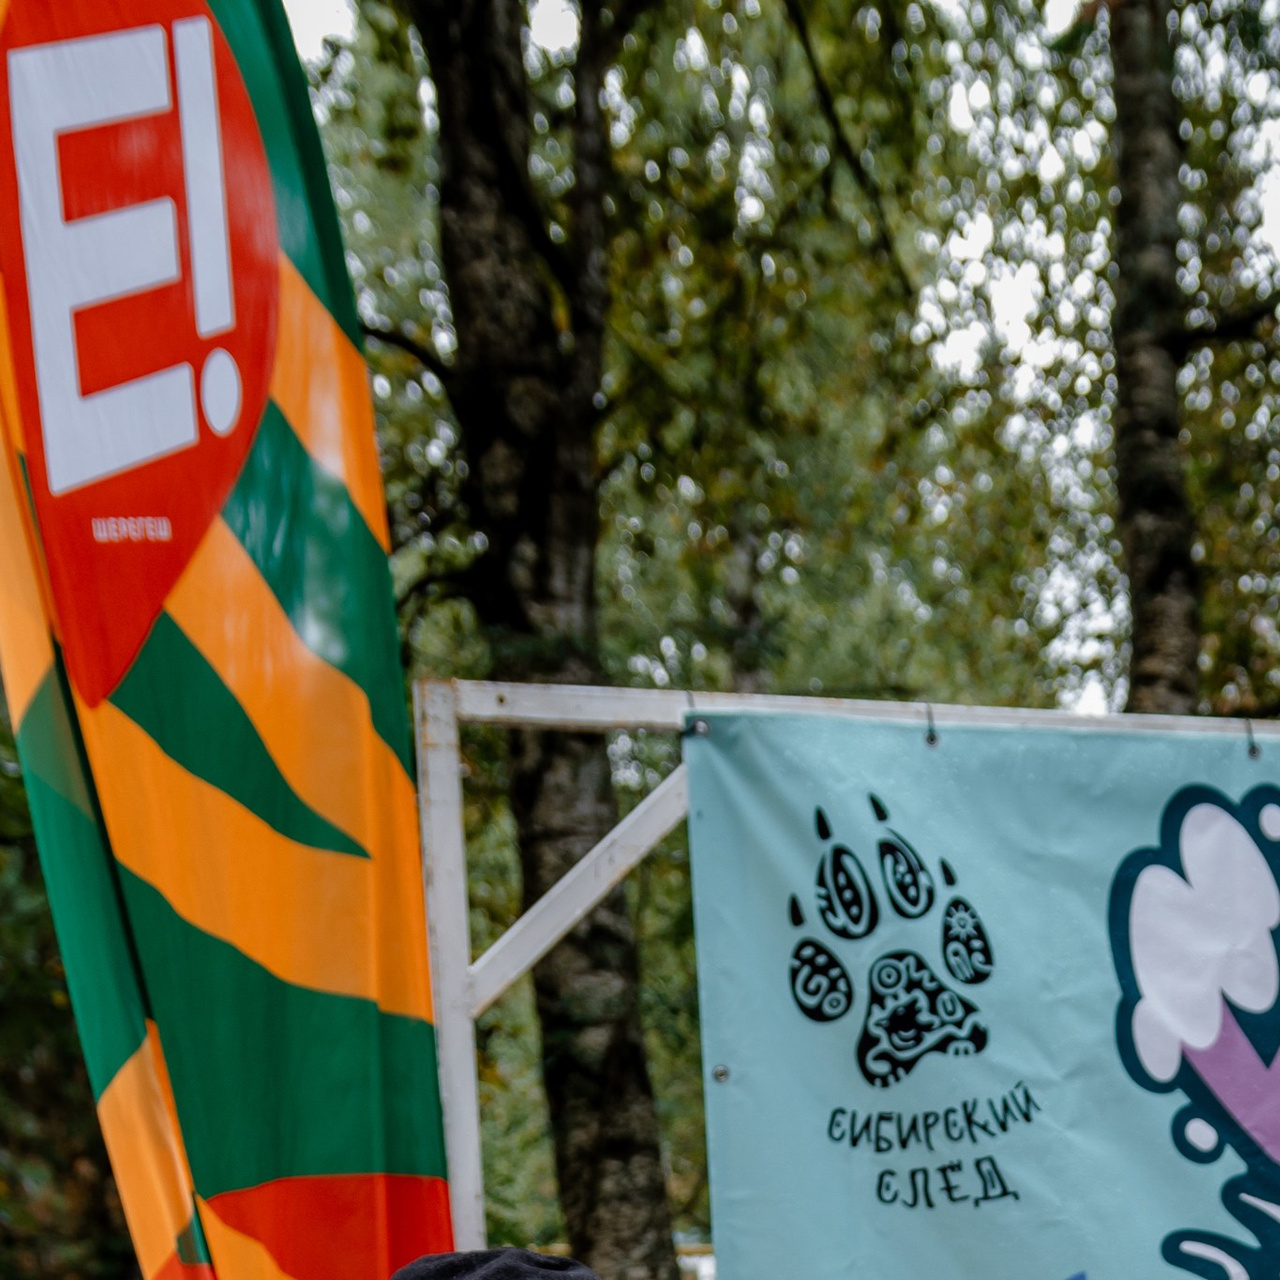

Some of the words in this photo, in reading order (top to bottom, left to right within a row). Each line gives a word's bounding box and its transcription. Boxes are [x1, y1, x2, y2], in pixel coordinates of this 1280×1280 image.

[92, 516, 172, 541] ШЕРЕГЕШ
[828, 1080, 1041, 1152] СИБИРСКИЙ
[877, 1155, 1020, 1208] СЛЕД
